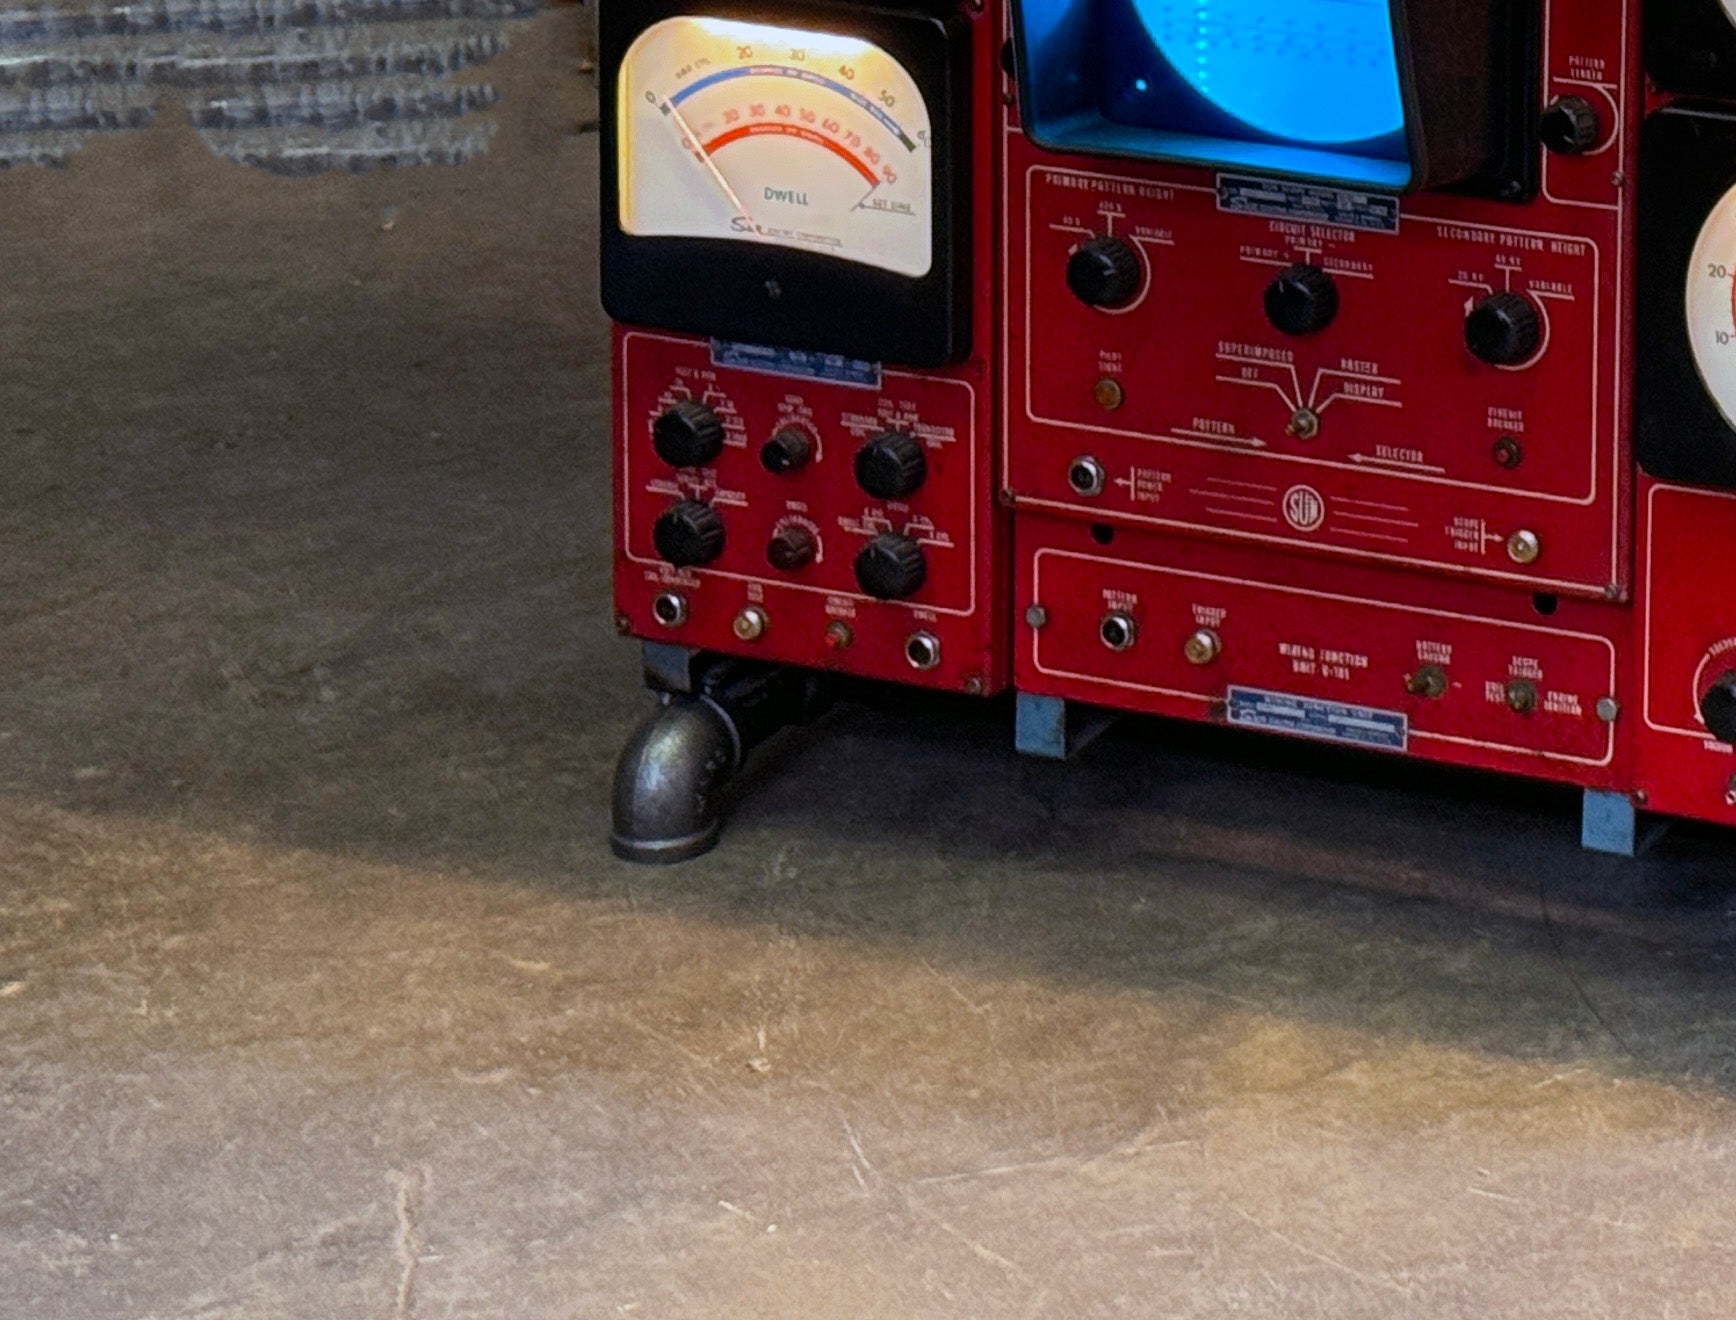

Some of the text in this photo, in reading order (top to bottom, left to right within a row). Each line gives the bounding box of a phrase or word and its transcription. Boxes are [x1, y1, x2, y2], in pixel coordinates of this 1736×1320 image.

[764, 186, 809, 206] DWELL
[1309, 224, 1356, 243] SELECTOR
[1436, 225, 1586, 257] SECONDARY PATTERN HEIGHT
[1708, 264, 1726, 279] 20
[1715, 331, 1729, 345] 10
[1217, 340, 1295, 362] SUPERIMPOSED
[1191, 417, 1236, 435] PATTERN
[1375, 444, 1424, 463] SELECTOR
